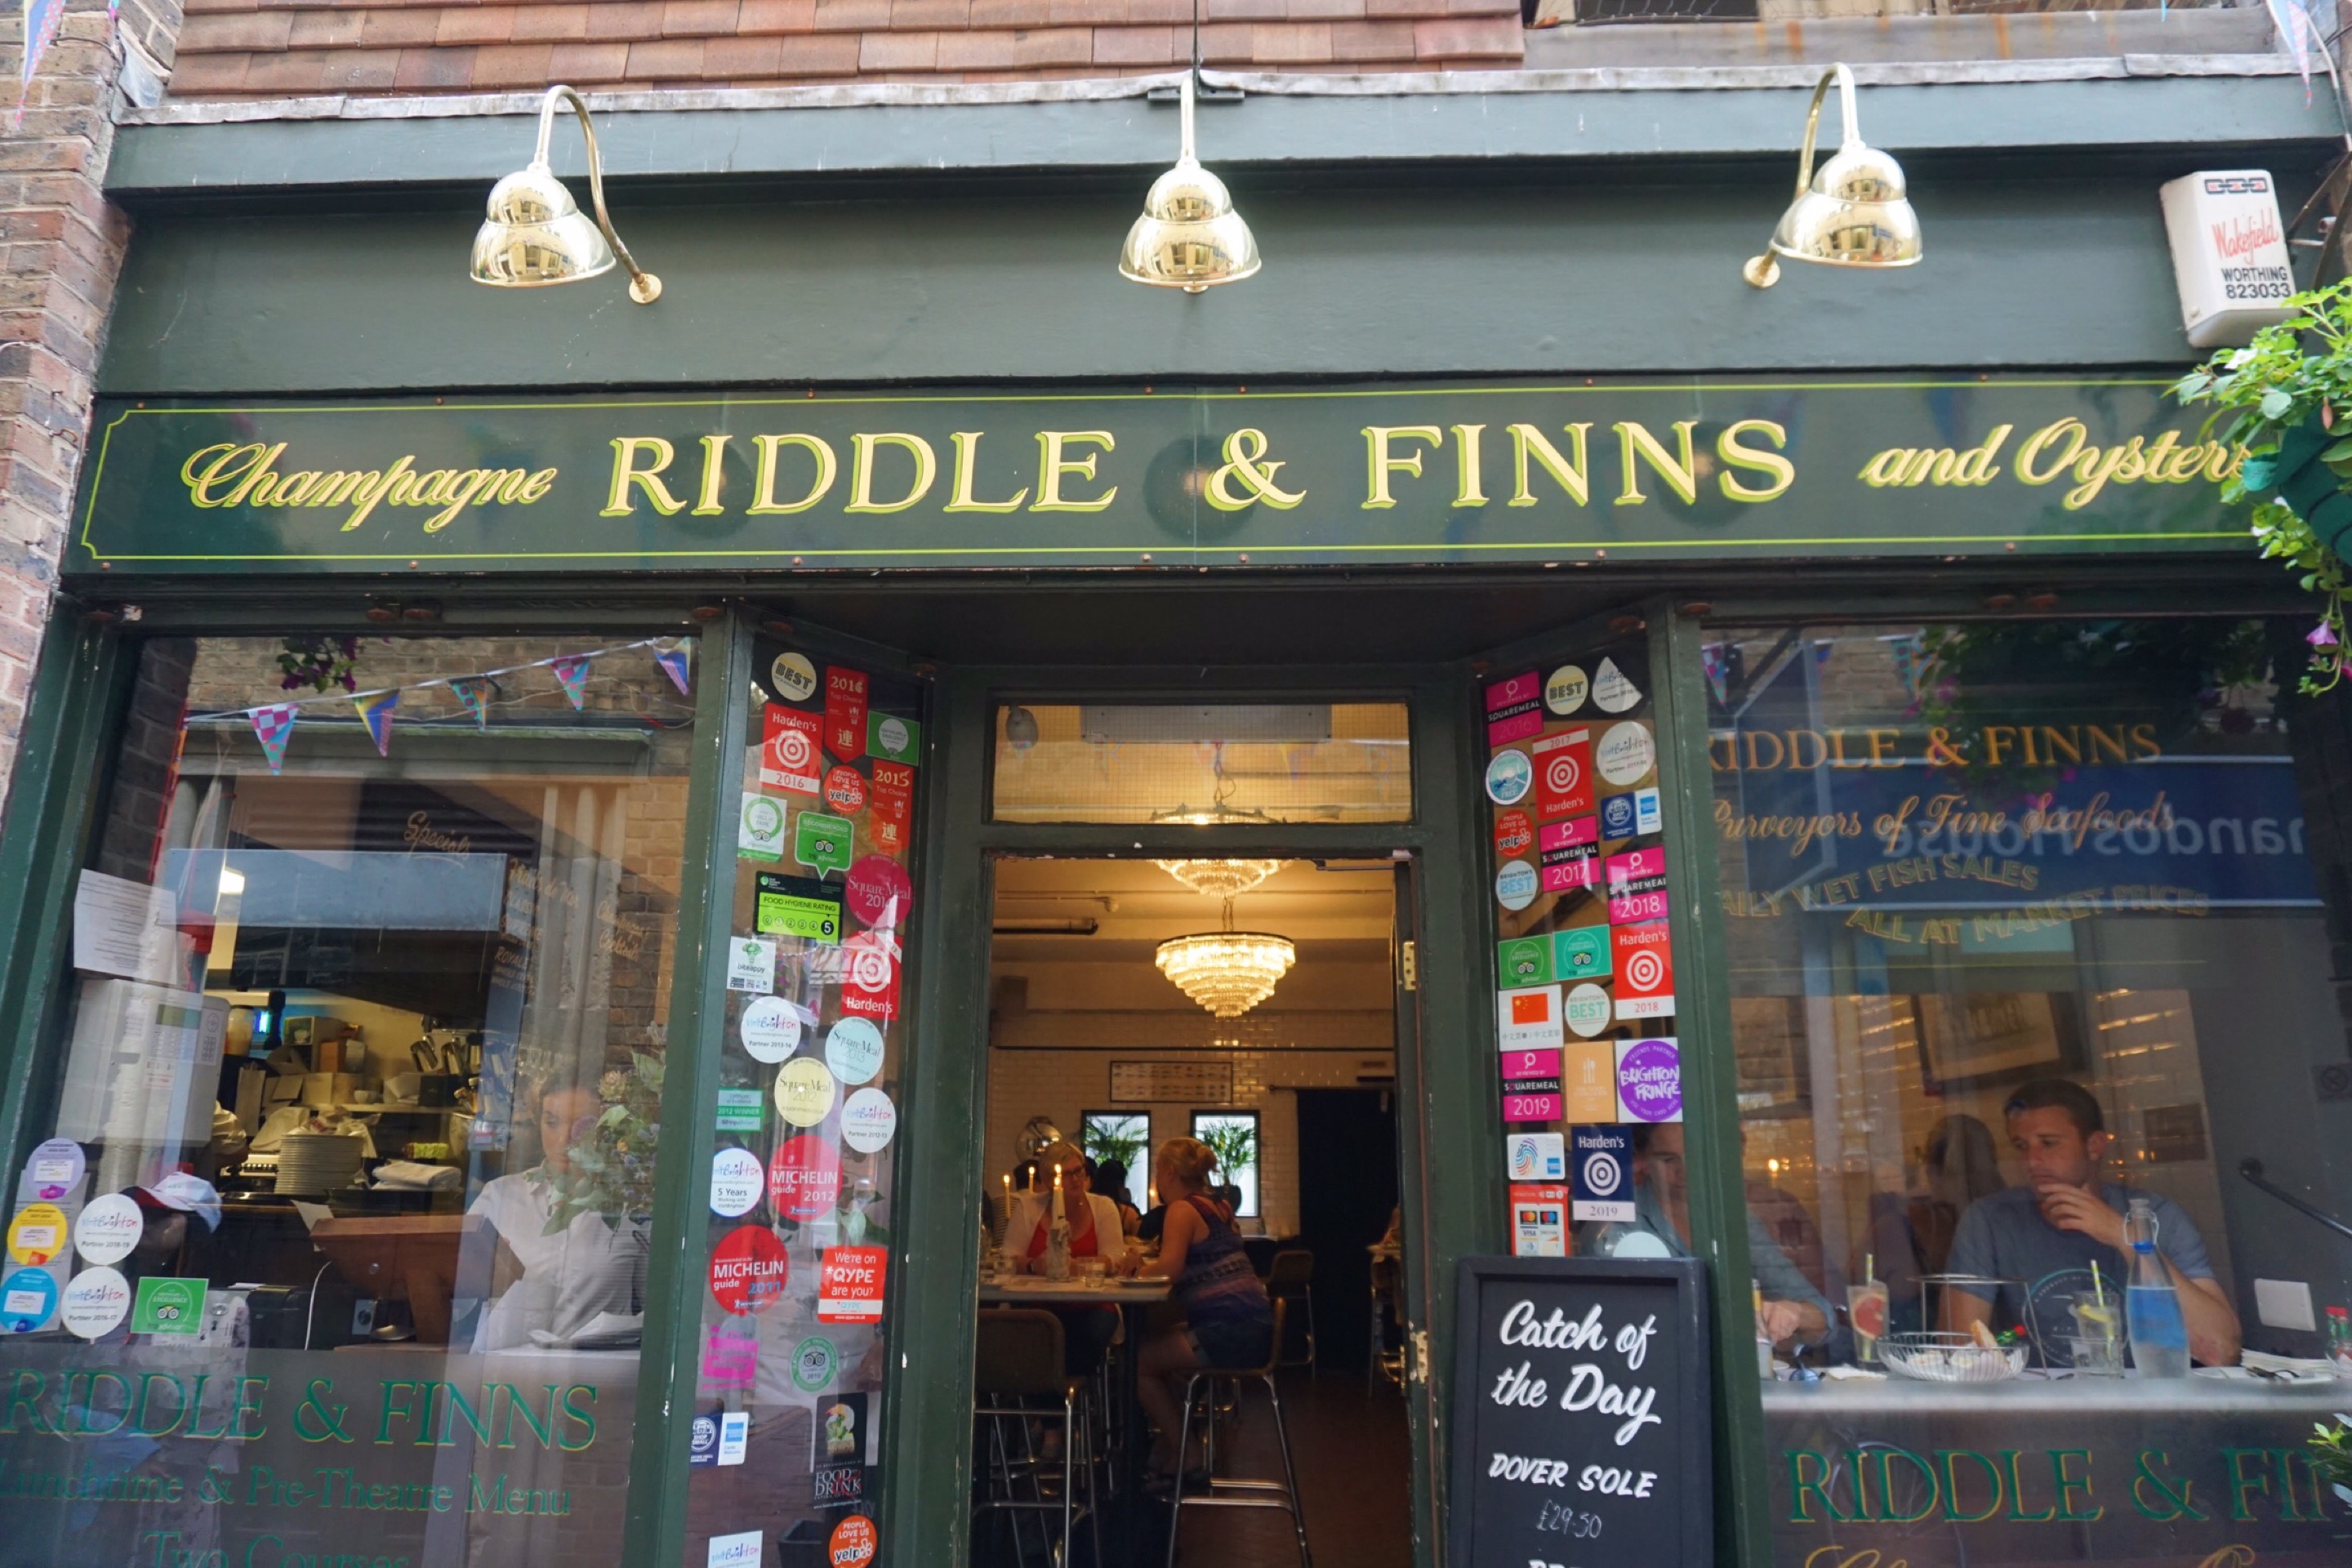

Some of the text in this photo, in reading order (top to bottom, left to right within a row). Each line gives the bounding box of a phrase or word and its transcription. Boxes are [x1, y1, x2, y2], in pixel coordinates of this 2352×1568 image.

[2212, 207, 2279, 265] Wakefield
[2221, 266, 2287, 282] WORTHING
[2225, 284, 2291, 299] 823033
[1858, 424, 2013, 488] and
[599, 419, 1795, 517] RIDDLE & FINNS
[181, 442, 559, 532] Champagne
[775, 662, 813, 690] BEST
[1549, 681, 1584, 700] BEST
[1488, 700, 1540, 722] SQUAREMEAL
[772, 712, 817, 732] Harden's
[1499, 719, 1532, 739] 2016
[1551, 736, 1570, 748] 2017
[1924, 726, 1969, 768] &
[1982, 724, 2162, 768] FINNS
[835, 769, 857, 779] PEOPLE
[875, 769, 910, 787] 2015
[1606, 765, 1625, 774] Partner
[776, 773, 804, 789] 2016
[832, 775, 850, 784] LOVE
[829, 788, 851, 804] yelp
[876, 785, 907, 798] Top Choice
[1546, 796, 1584, 813] Harden's
[803, 818, 849, 833] RECOMMENDED
[1713, 799, 1862, 858] Purveyors
[1874, 795, 1919, 853] of
[1923, 793, 2007, 835] Fine
[403, 810, 470, 860] Specials
[1499, 835, 1520, 849] yelp
[1542, 846, 1597, 863] SQUAREMEAL
[1499, 869, 1533, 880] BRIGHTON'S
[1552, 863, 1588, 885] 2017
[1791, 872, 1860, 911] WET
[1868, 858, 1938, 893] FISH
[1943, 853, 2039, 890] SALES
[1500, 875, 1533, 894] BEST
[764, 897, 836, 912] FOOD HYGIENE RATING
[1620, 895, 1660, 918] 2018
[1845, 906, 1912, 942] ALL
[1919, 918, 1962, 943] AT
[1972, 888, 2105, 942] MARKET
[1619, 931, 1667, 946] Harden's
[846, 996, 893, 1013] Harden's
[1570, 1001, 1606, 1018] BEST
[1634, 1002, 1659, 1013] 2018
[843, 1045, 866, 1062] 2013
[1620, 1065, 1680, 1086] BRIGHTON
[1503, 1081, 1558, 1091] SQUAREMEAL
[1634, 1080, 1681, 1101] FRINGE
[793, 1091, 817, 1102] 2012
[718, 1107, 733, 1115] 2012
[1514, 1098, 1550, 1116] 2019
[1579, 1136, 1624, 1148] Harden's
[772, 1170, 837, 1184] MICHELIN
[725, 1188, 747, 1196] Years
[771, 1185, 835, 1201] guide 2012
[1589, 1206, 1618, 1216] 2019
[835, 1252, 876, 1264] We're on
[714, 1260, 784, 1278] MICHELIN
[714, 1279, 782, 1294] guide 2011
[831, 1285, 874, 1298] are you?
[1499, 1299, 1657, 1370] Catch of
[0, 1368, 598, 1451] RIDDLE & FINNS
[1491, 1360, 1661, 1446] the Day
[816, 1468, 852, 1484] FOOD
[1488, 1452, 1658, 1499] DOVER SOLE
[198, 1465, 234, 1504] &
[245, 1465, 453, 1512] Pre-Theatre
[465, 1472, 572, 1516] Menu
[815, 1478, 862, 1496] DRINK
[1783, 1449, 2104, 1524] RIDDLE
[2129, 1449, 2210, 1522] &
[839, 1530, 858, 1539] LOVE
[144, 1530, 229, 1568] Two
[835, 1546, 860, 1565] yelp
